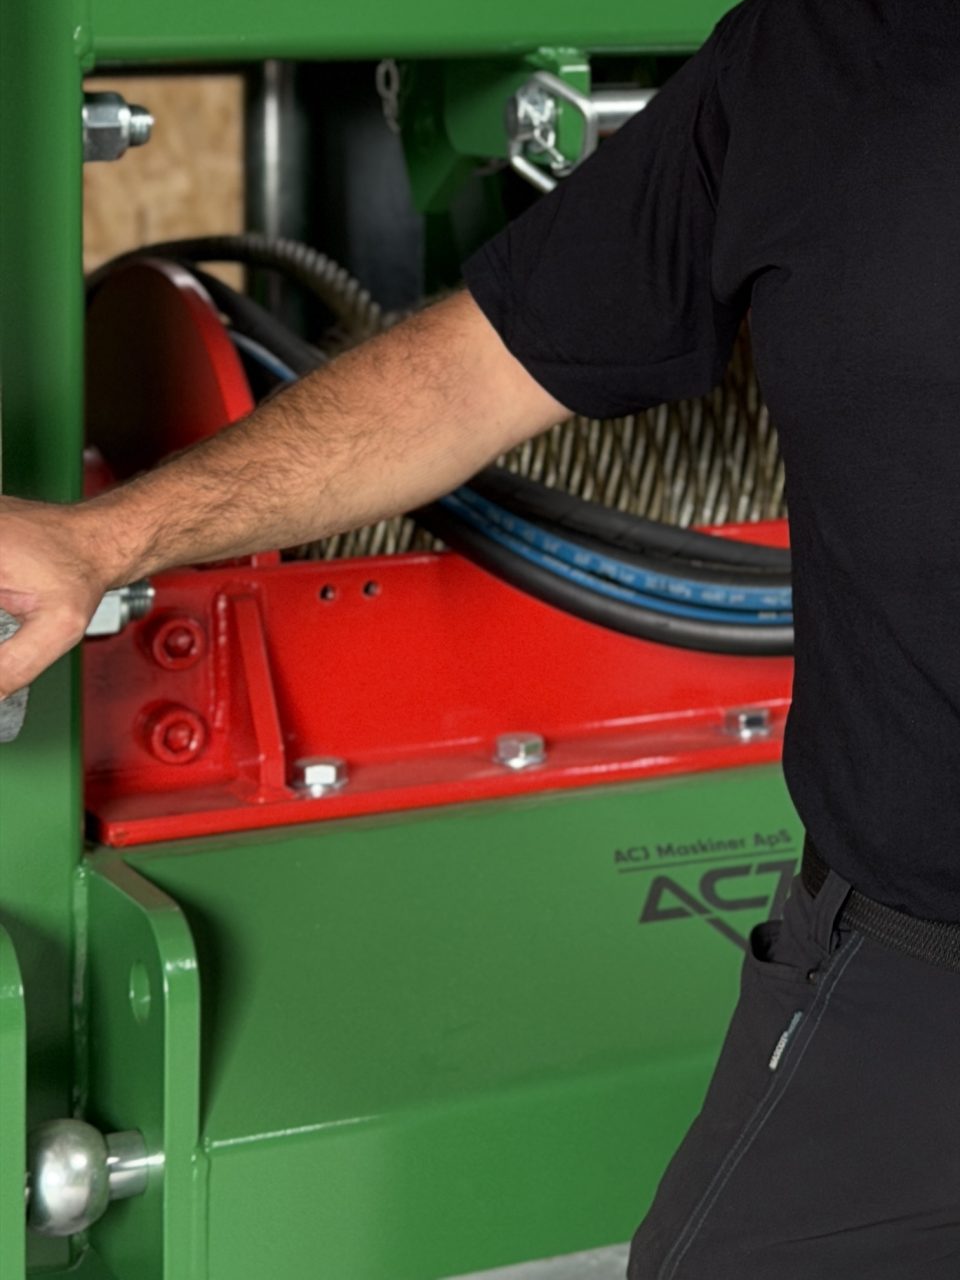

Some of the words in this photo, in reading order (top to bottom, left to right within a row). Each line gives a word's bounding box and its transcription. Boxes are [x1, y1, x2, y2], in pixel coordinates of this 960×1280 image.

[613, 846, 650, 865] ACJ
[655, 837, 747, 859] Maskiner
[753, 828, 792, 848] ApS
